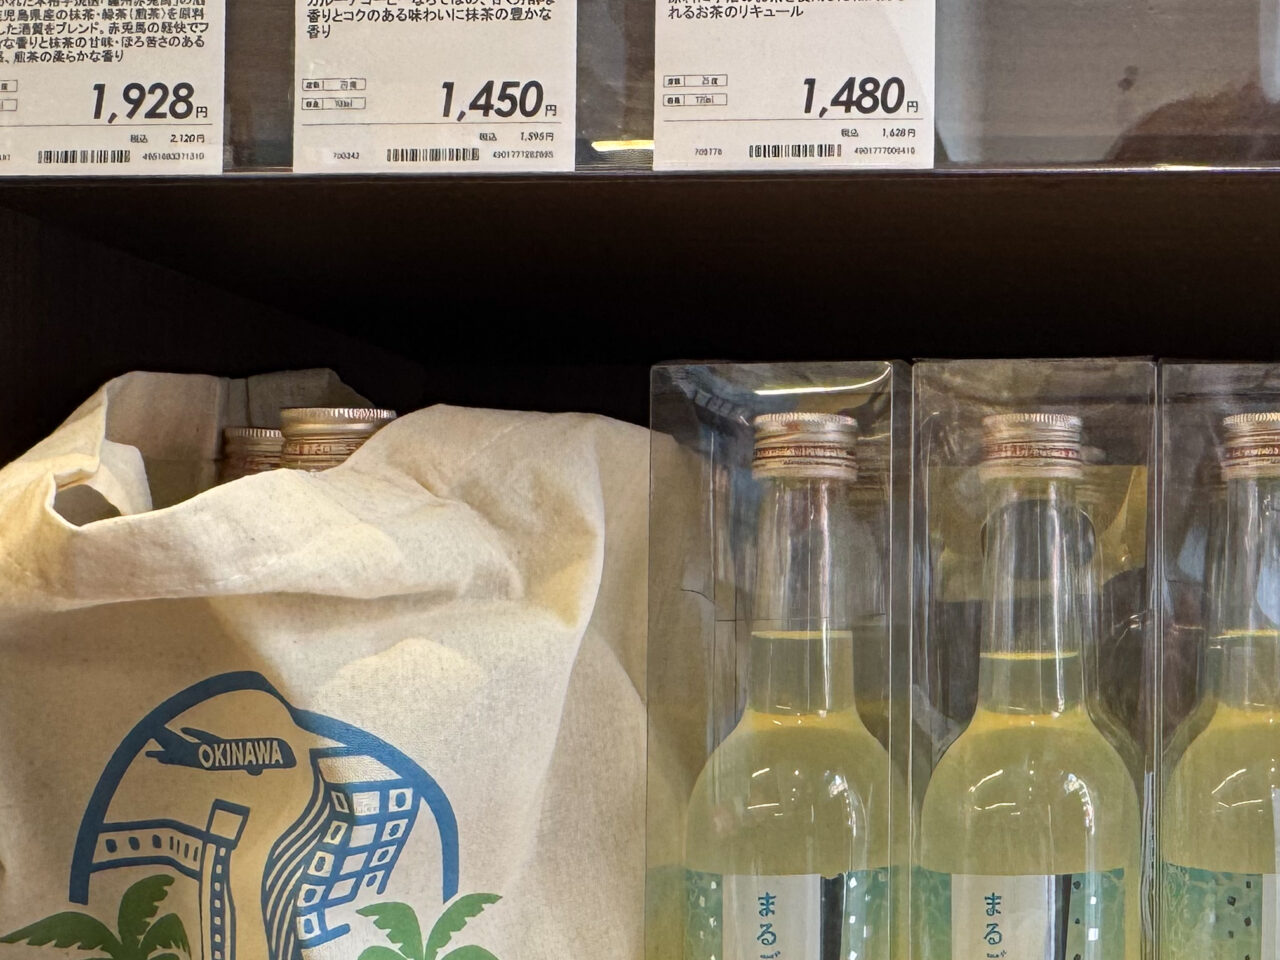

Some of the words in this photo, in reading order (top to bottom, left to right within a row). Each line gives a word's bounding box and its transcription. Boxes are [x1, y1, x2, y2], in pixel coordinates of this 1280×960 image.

[307, 8, 551, 22] 香りとコクのある味わいに抹茶の豊かな
[668, 5, 804, 19] れるお茶のリキュール
[307, 24, 331, 38] 香り
[198, 739, 284, 768] OKINAWA
